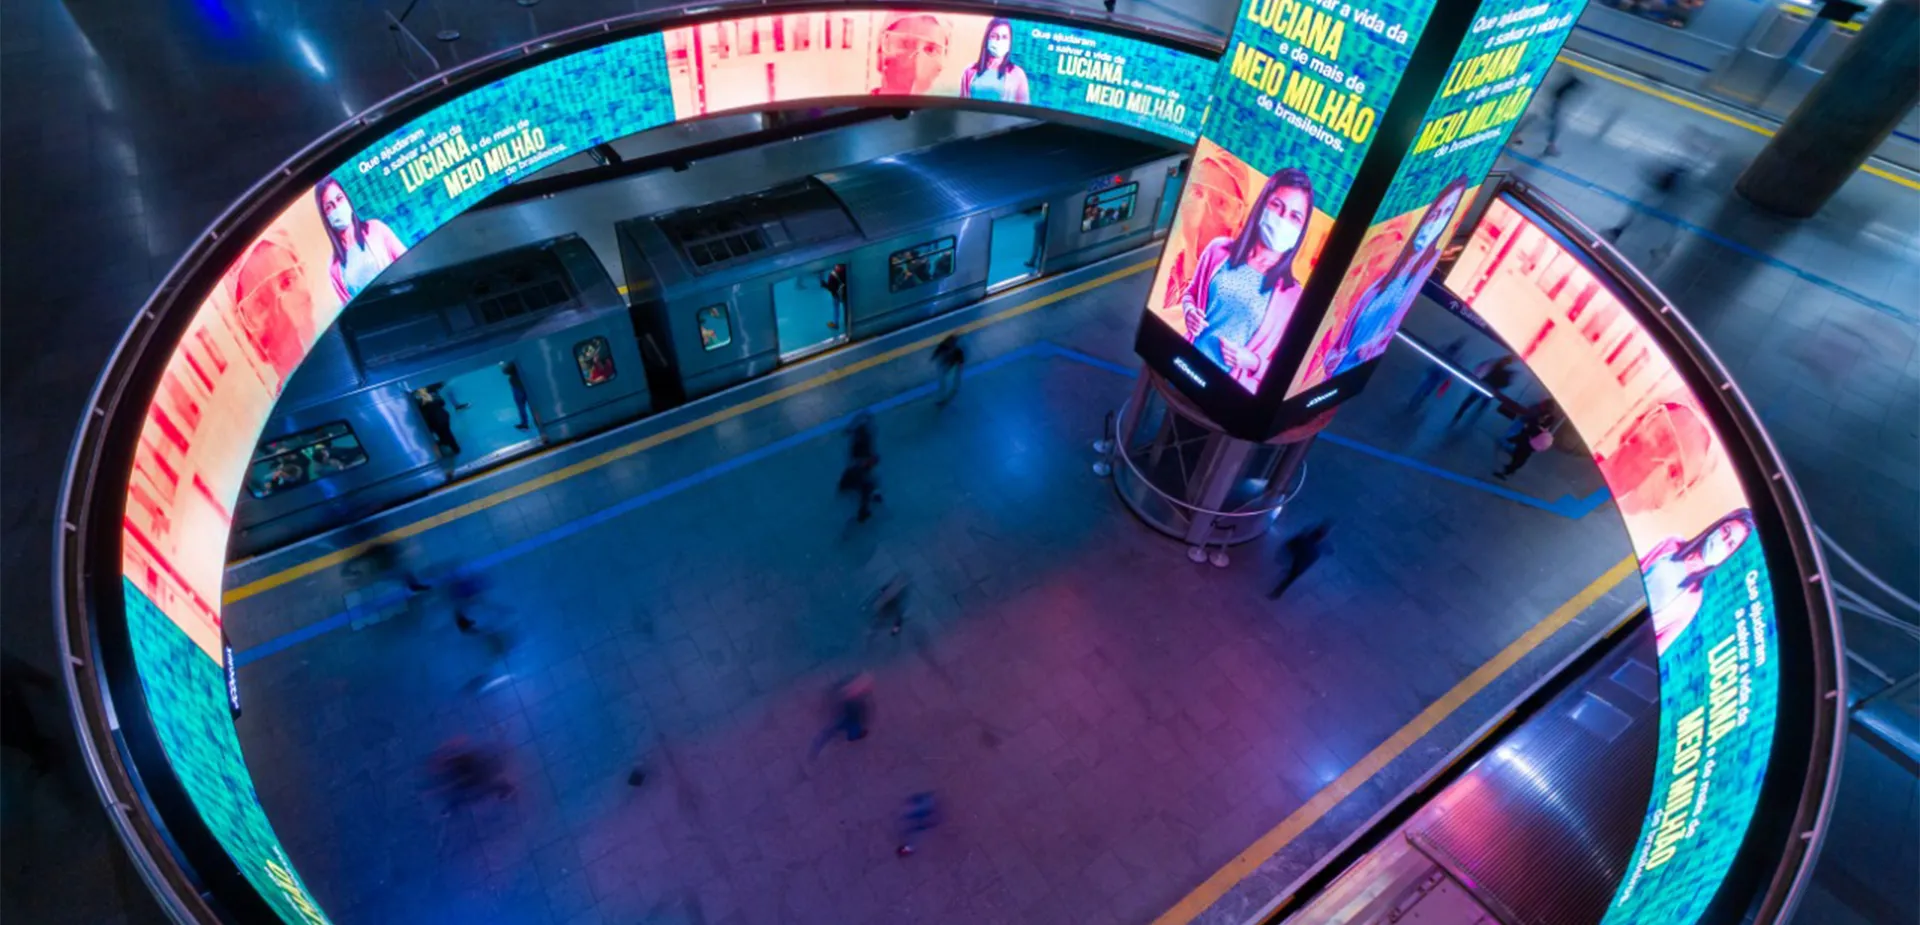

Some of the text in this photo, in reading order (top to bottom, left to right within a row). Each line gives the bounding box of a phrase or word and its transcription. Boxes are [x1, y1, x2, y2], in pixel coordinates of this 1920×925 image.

[1031, 28, 1096, 48] Que ajudaram
[1247, 0, 1345, 61] LUCIANA
[1340, 4, 1351, 18] a
[1354, 9, 1386, 33] vida
[1386, 24, 1408, 44] da
[1473, 16, 1498, 33] Que
[1055, 45, 1083, 56] salvar
[1092, 50, 1112, 62] vida
[1113, 55, 1126, 65] da
[1057, 53, 1123, 85] LUCIANA
[1130, 79, 1144, 89] de
[1167, 89, 1180, 100] de
[1279, 43, 1366, 94] e de mais de
[1441, 41, 1529, 98] LUCIANA
[1086, 83, 1125, 109] MEIO
[1126, 91, 1186, 125] MILHÃO
[1230, 42, 1286, 97] MEIO
[1283, 70, 1375, 144] MILHÃO
[1257, 95, 1345, 152] de brasileiros.
[1412, 110, 1468, 155] MEIO
[358, 128, 426, 174] Que ajudaram
[383, 124, 463, 176] a salvar a vida da
[400, 134, 471, 193] LUCIANA
[479, 136, 493, 148] de
[493, 125, 517, 142] mais
[516, 119, 530, 131] de
[443, 127, 546, 199] MEIO MILHÃO
[504, 164, 518, 176] de
[1433, 144, 1449, 158] de
[1745, 569, 1759, 601] Que
[1706, 633, 1739, 748] LUCIANA
[1645, 705, 1704, 870] MEIO MILHÃO
